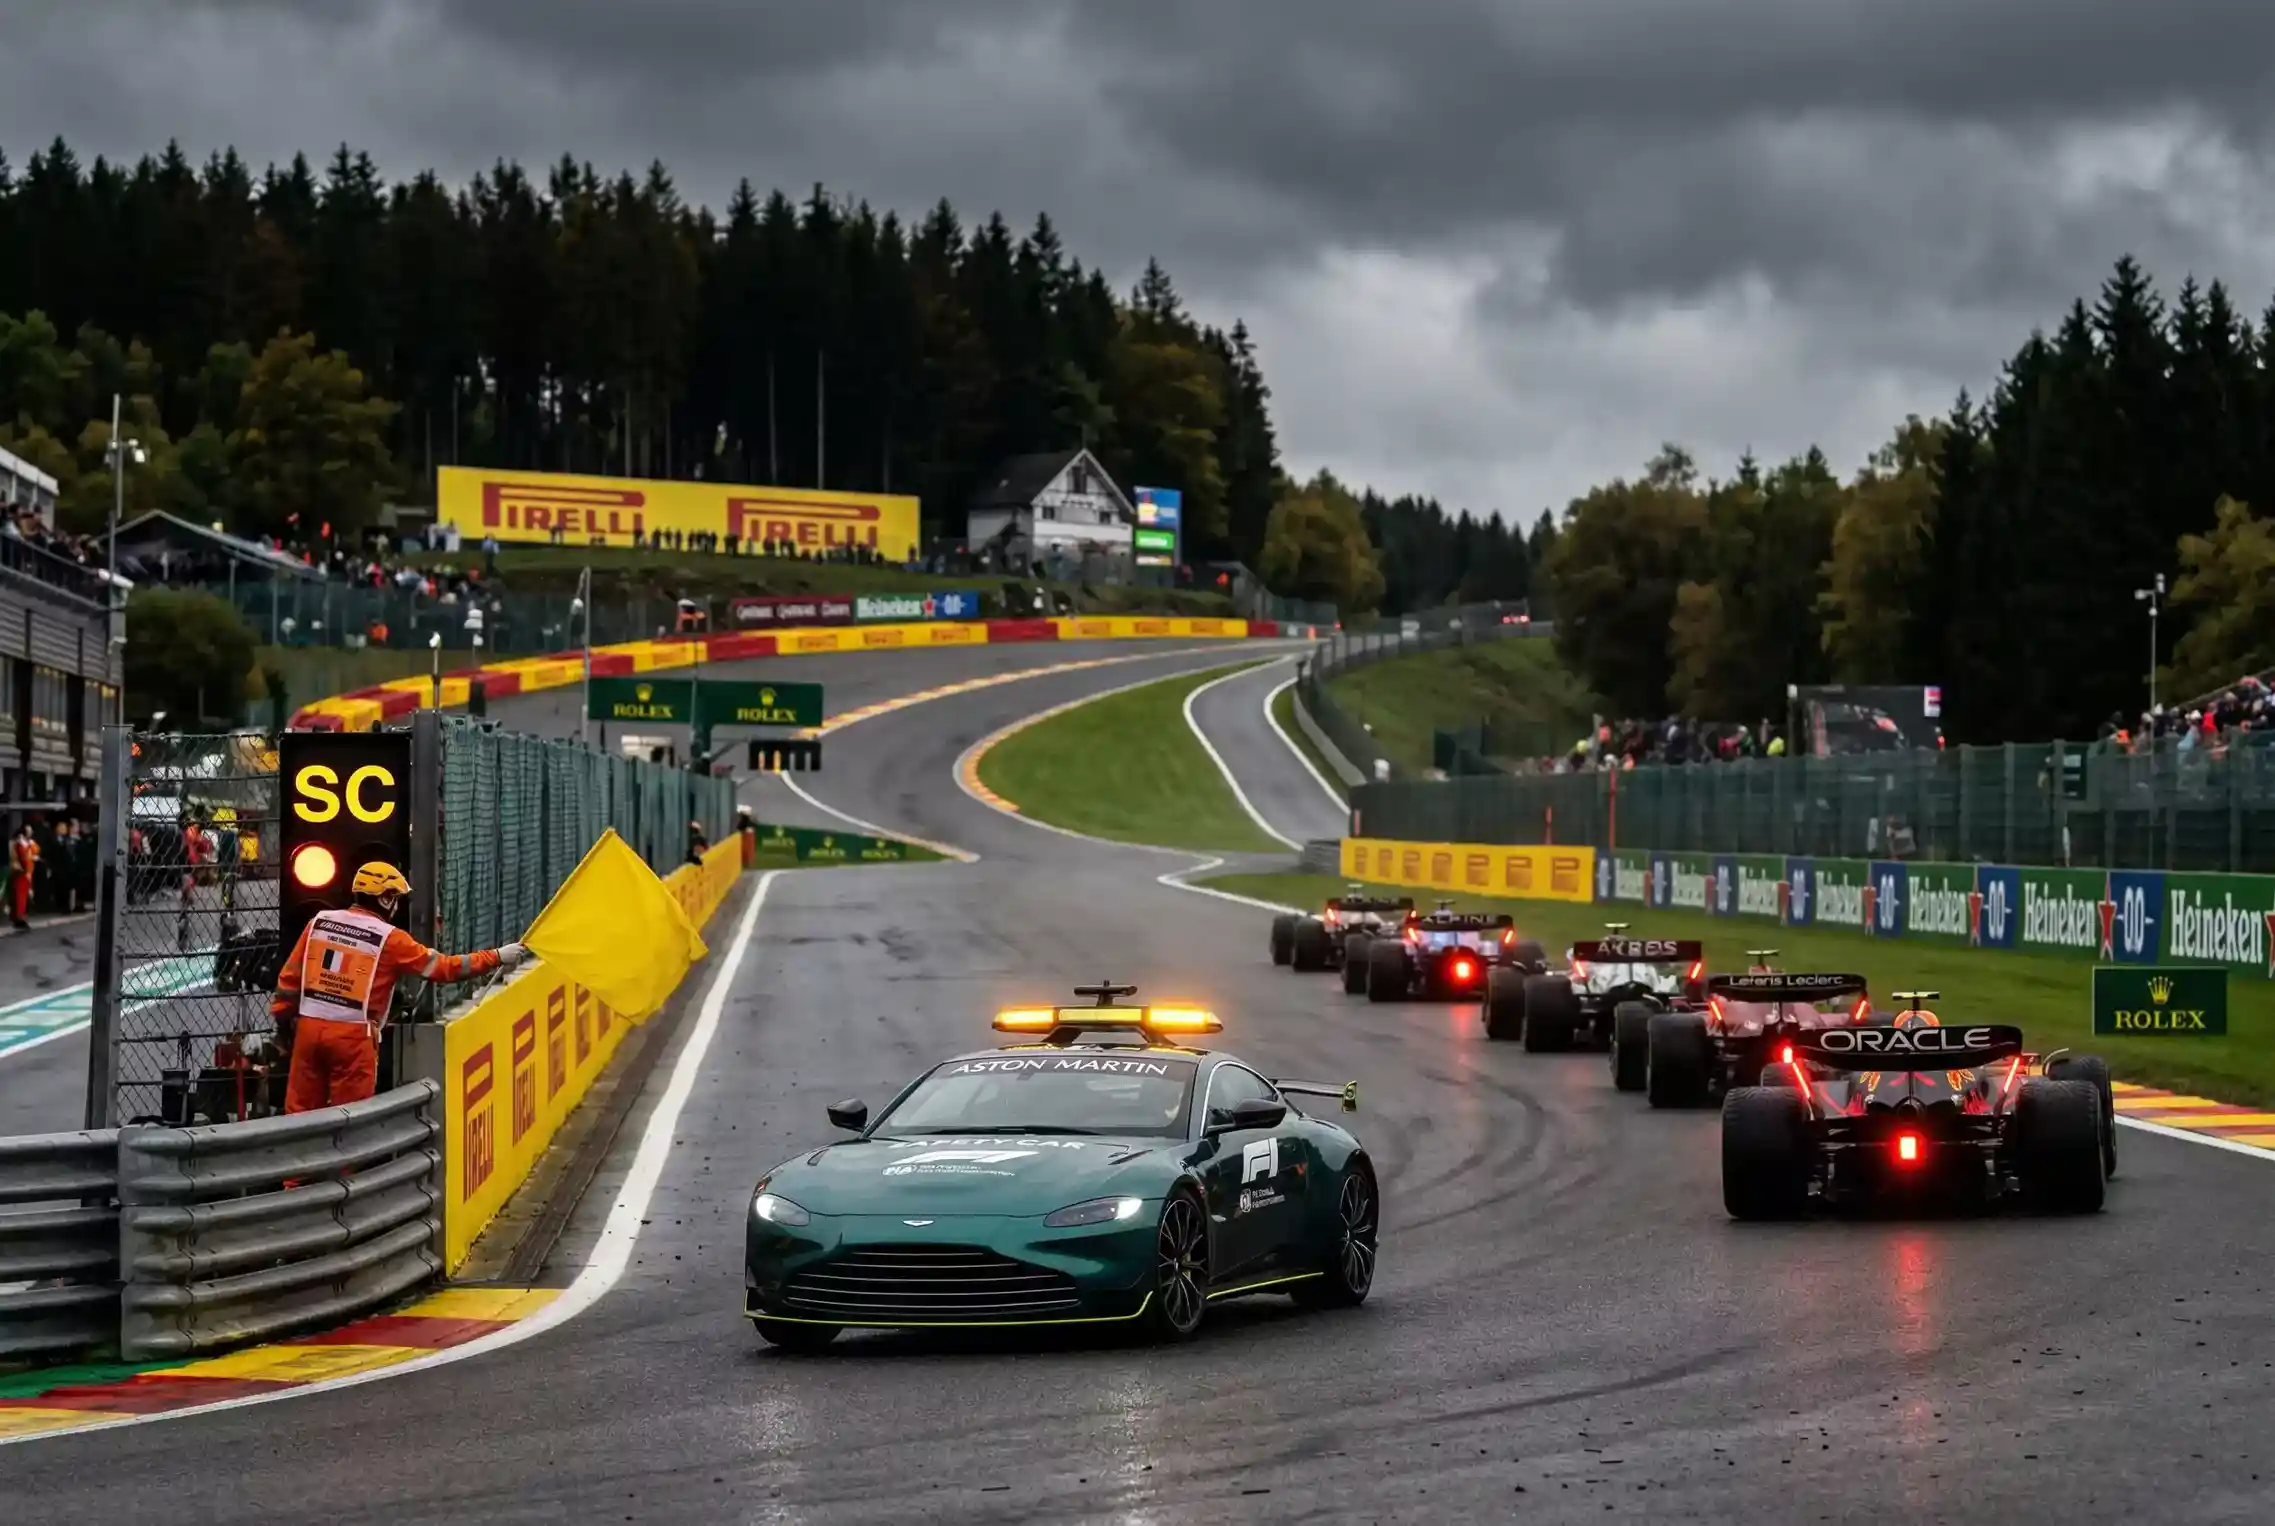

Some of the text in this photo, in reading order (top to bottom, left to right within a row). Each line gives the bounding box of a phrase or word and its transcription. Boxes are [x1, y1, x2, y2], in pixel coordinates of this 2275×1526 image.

[482, 482, 645, 533] PIRELLI
[727, 498, 881, 548] PIRELLI
[613, 703, 673, 718] ROLEX
[737, 707, 797, 722] ROLEX
[293, 764, 396, 824] SC
[2023, 881, 2097, 947] Heineken
[2169, 889, 2264, 964] Heineken
[2114, 1009, 2207, 1030] ROLEX
[1820, 1027, 1991, 1052] ORACLE
[951, 1058, 1169, 1076] ASTON MARTIN
